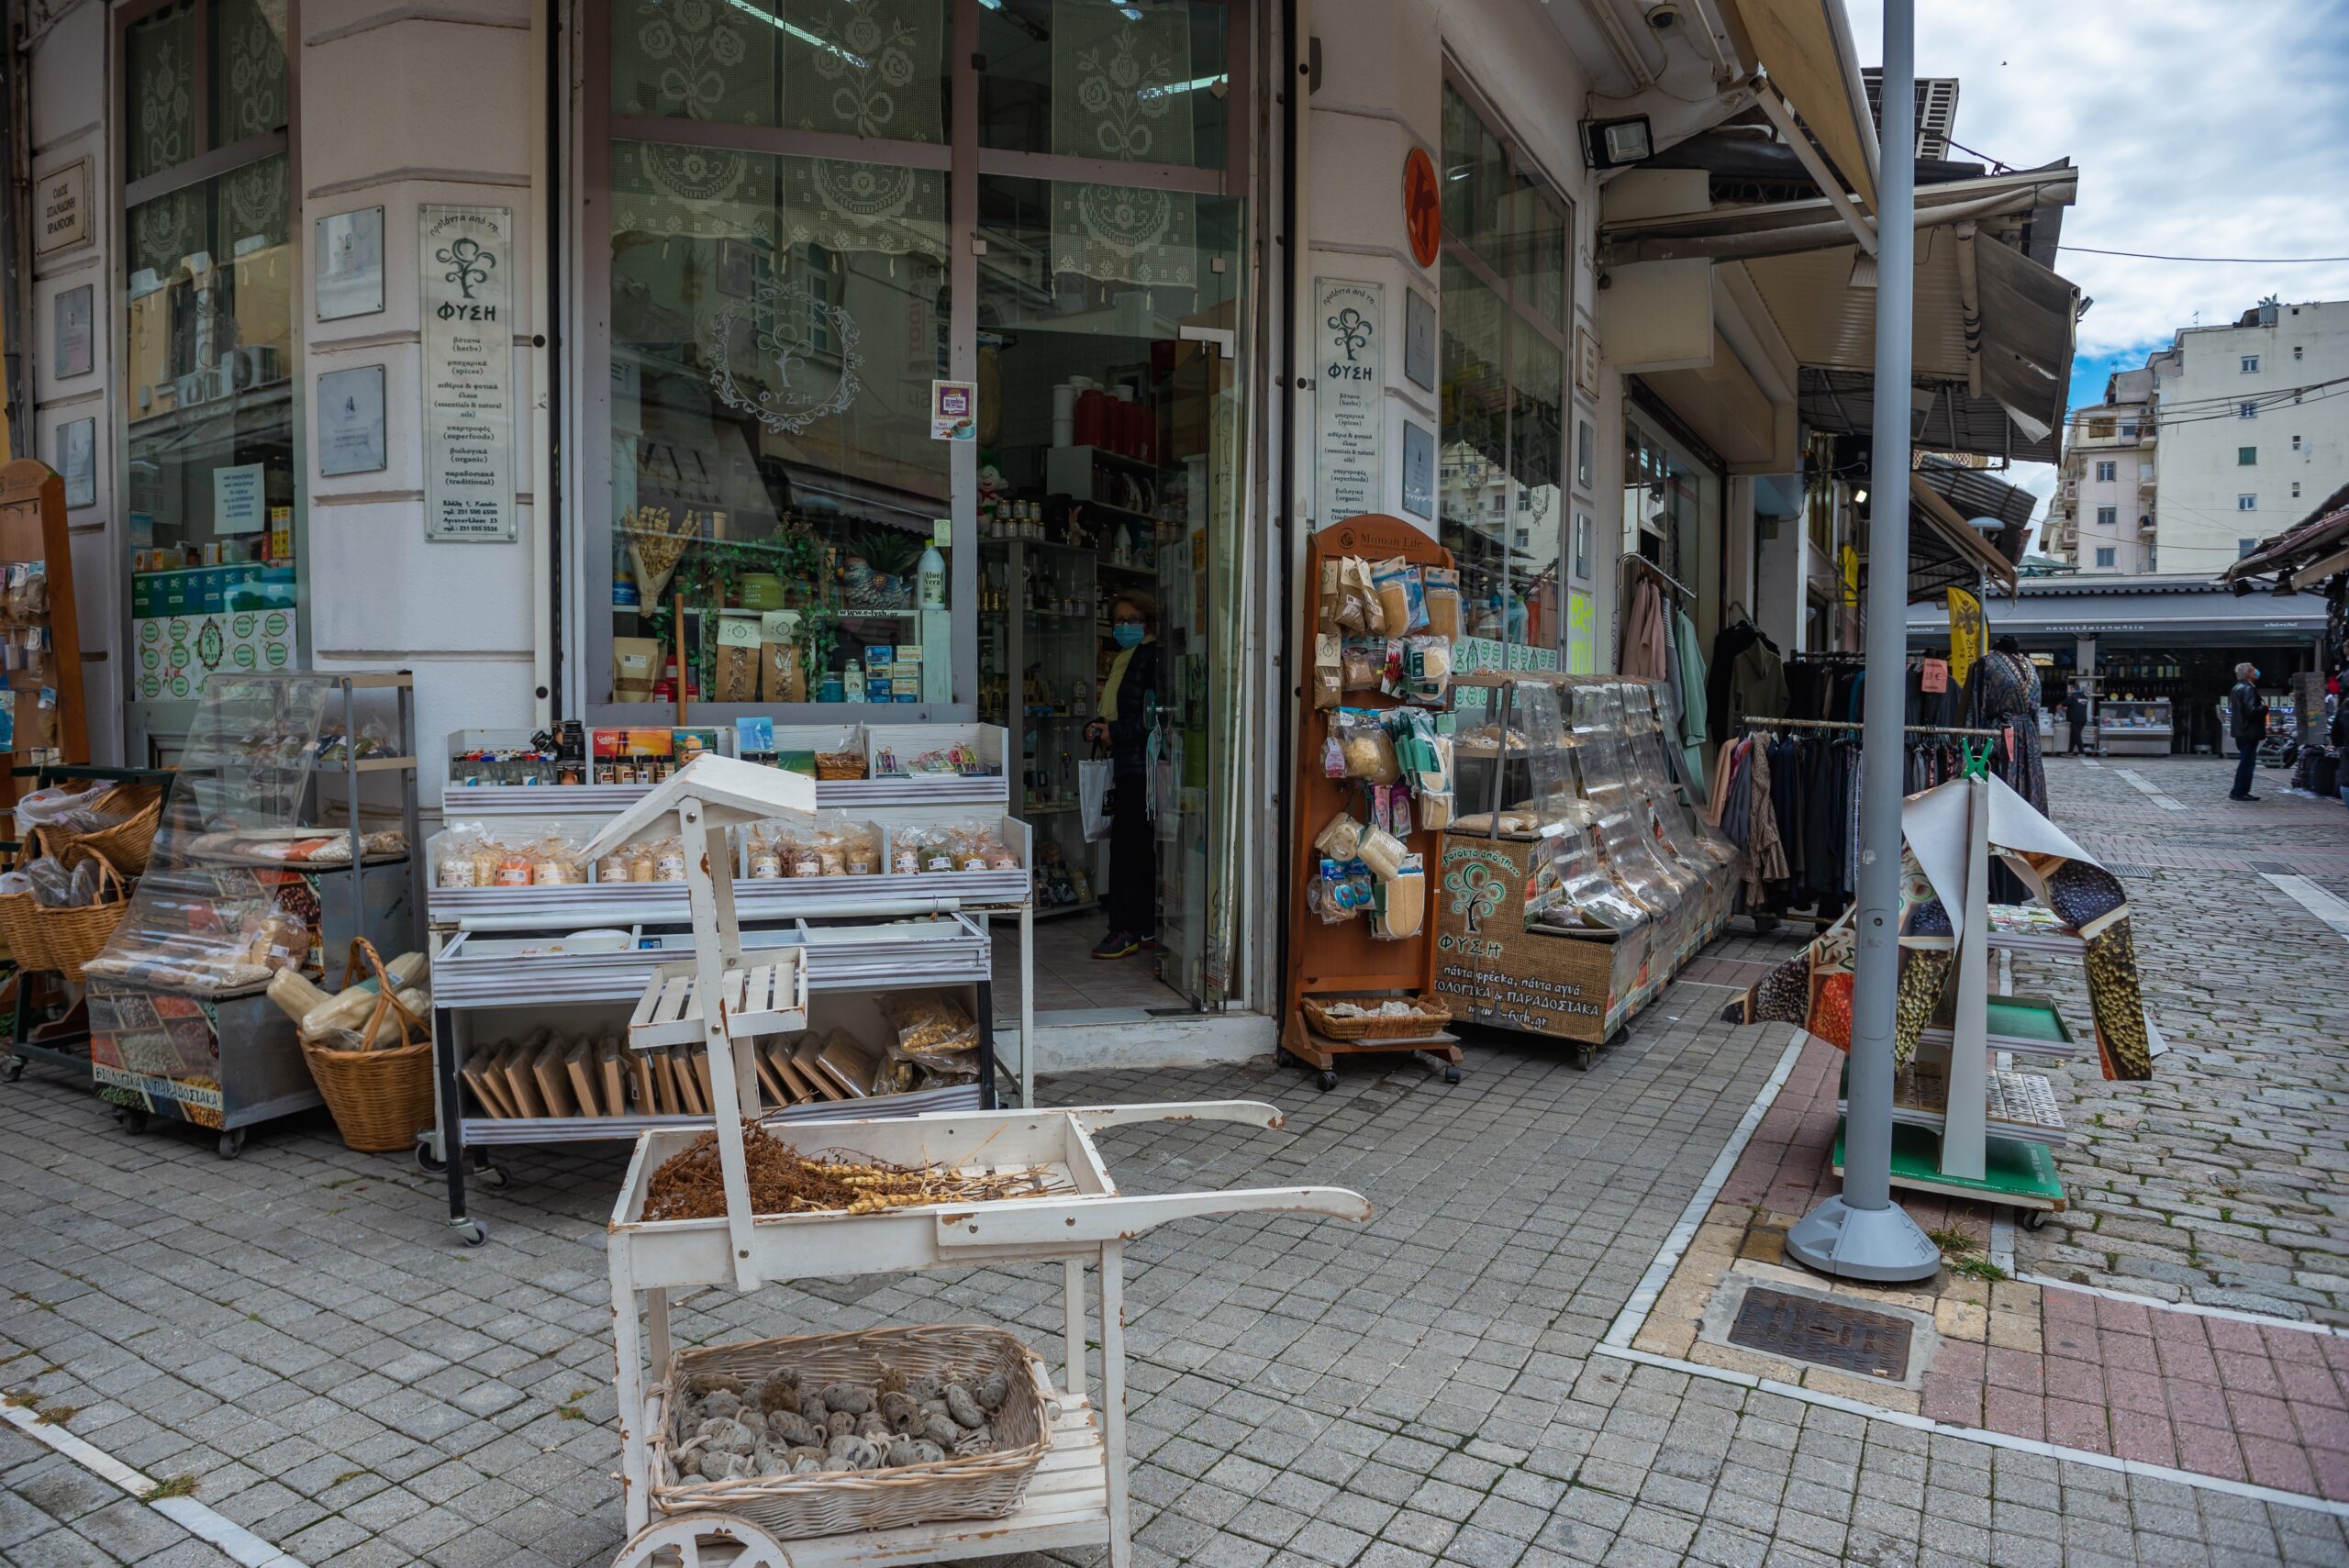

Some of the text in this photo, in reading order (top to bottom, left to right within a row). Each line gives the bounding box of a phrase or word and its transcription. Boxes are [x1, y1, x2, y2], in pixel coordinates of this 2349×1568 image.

[53, 183, 67, 199] ΟΔΟΣ
[469, 216, 486, 225] από
[437, 301, 496, 321] ΦΥΣΗ
[452, 344, 482, 352] (herbs)
[1328, 361, 1372, 381] ΦΥΣΗ
[438, 382, 463, 390] αιθέρια
[434, 400, 470, 408] (essentials
[759, 391, 814, 406] ΦΥΣΗ
[1339, 399, 1361, 407] (herbs)
[451, 455, 488, 463] (organic)
[445, 478, 495, 486] (traditional)
[1330, 475, 1369, 484] (superfoods)
[1362, 533, 1399, 545] Minoan
[1404, 537, 1423, 548] Life
[1443, 850, 1478, 866] ροϊόντα
[1481, 851, 1498, 862] από
[1440, 935, 1501, 957] ΦΥΣΗ
[1443, 964, 1580, 996] πάντα φρέσκα, πάντα αγνά
[1434, 980, 1598, 1017] ΙΟΛΟΓΙΚΑ & ΠΑΡΑΔΟΣΙΑΚΑ
[95, 1067, 217, 1106] ΒΙΟΛΟΓΙΚΑ & ΠΑΡΑΔΟΣΙΑΚΑ
